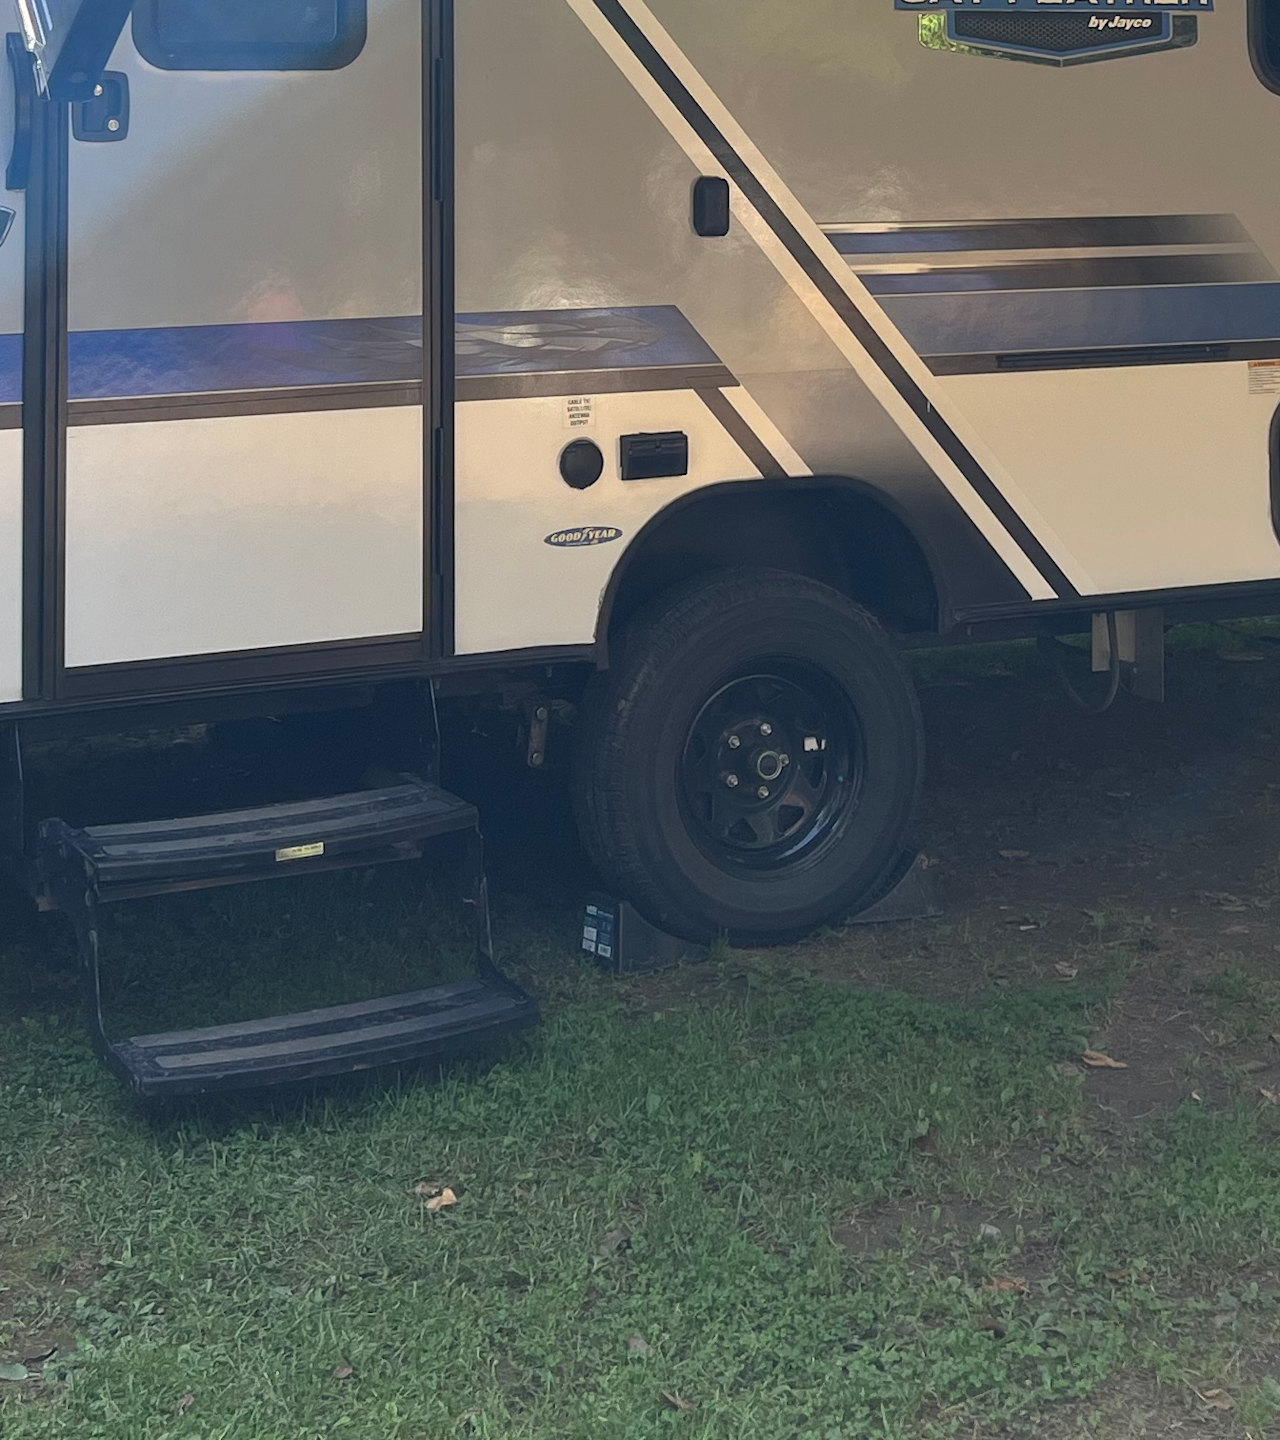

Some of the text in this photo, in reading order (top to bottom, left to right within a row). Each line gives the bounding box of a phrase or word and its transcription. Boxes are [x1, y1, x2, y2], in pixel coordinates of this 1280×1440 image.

[1088, 15, 1152, 30] by Jayco
[550, 528, 616, 543] GOODYEAR
